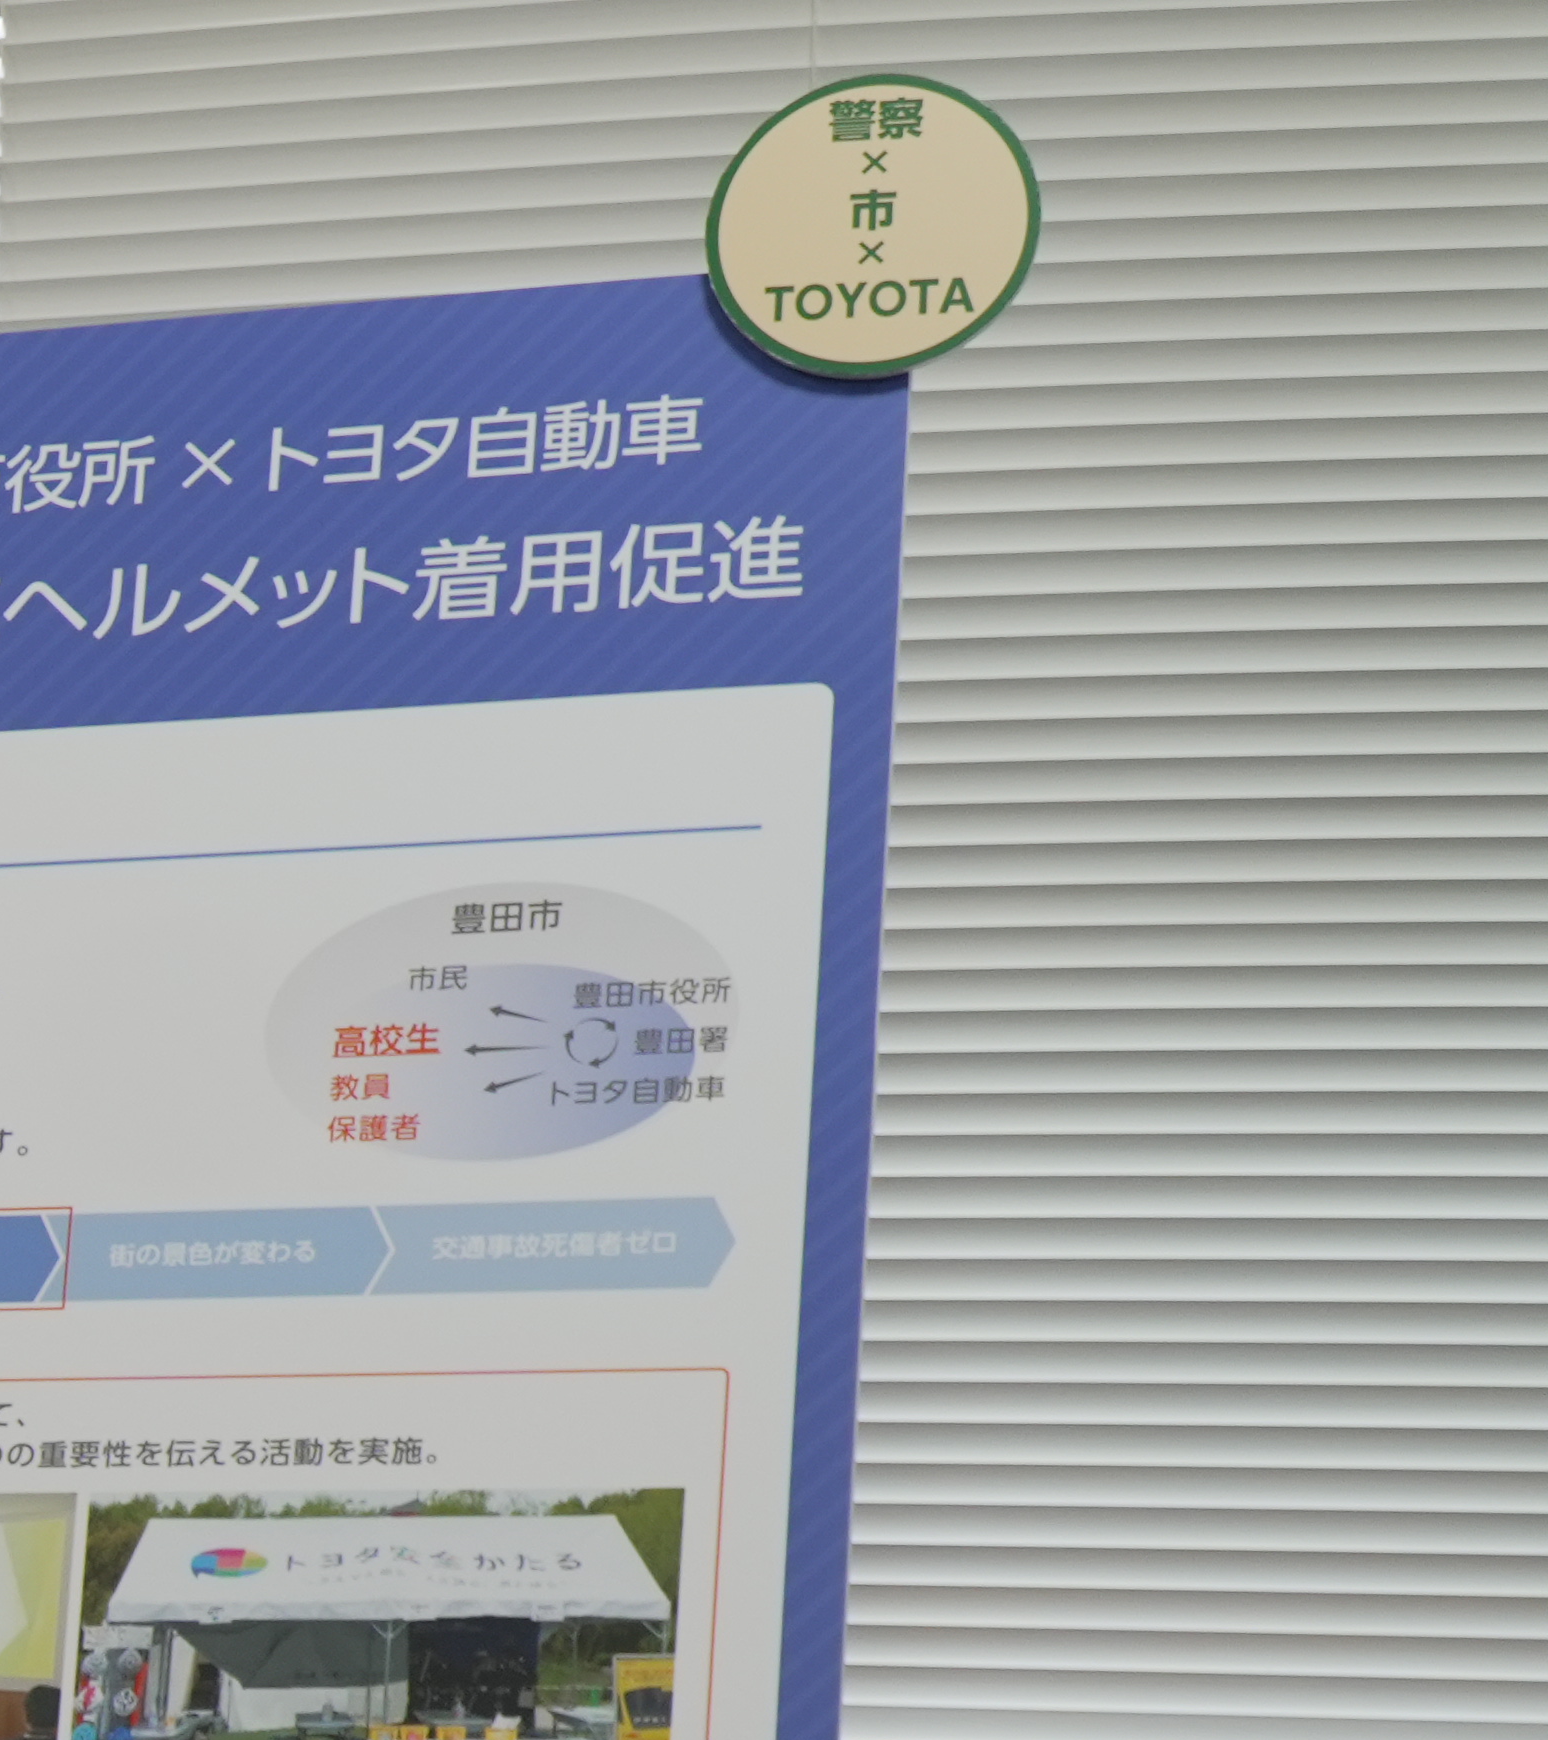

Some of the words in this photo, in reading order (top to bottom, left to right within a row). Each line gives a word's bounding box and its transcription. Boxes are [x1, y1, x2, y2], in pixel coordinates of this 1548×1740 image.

[829, 97, 924, 142] 警察
[850, 189, 897, 231] 市
[764, 277, 975, 322] TOYOTA
[265, 391, 702, 493] トヨタ自動車
[451, 900, 563, 935] 豊田市
[408, 964, 468, 992] 市民
[572, 976, 731, 1009] 豊田市役所
[332, 1023, 440, 1058] 高校生
[633, 1026, 729, 1055] 豊田署
[329, 1073, 390, 1101] 教員
[548, 1075, 726, 1104] トヨタ自動車
[326, 1113, 421, 1142] 保護者
[108, 1238, 317, 1268] 街の景色が変わる
[431, 1230, 678, 1262] 交通事故死傷者ゼロ
